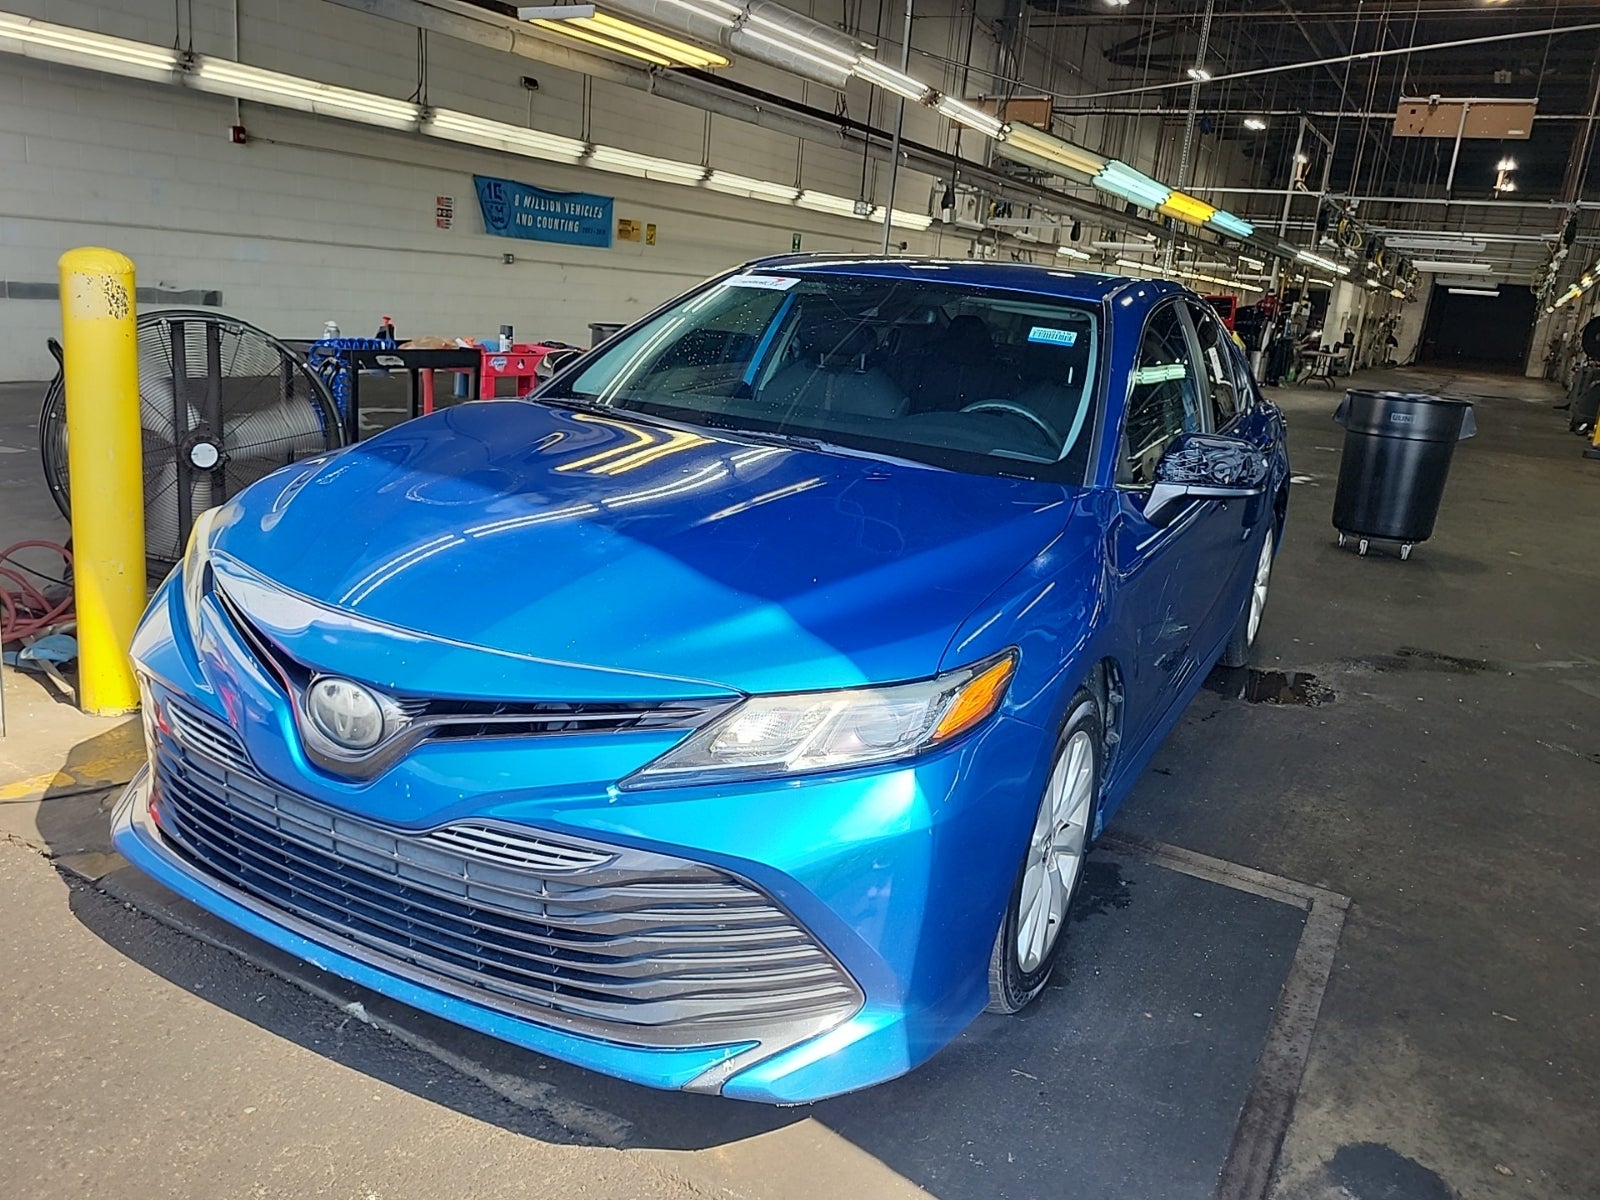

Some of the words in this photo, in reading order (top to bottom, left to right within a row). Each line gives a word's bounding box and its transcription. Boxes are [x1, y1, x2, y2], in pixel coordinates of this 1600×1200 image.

[523, 195, 561, 212] MILLION
[564, 203, 603, 219] VEHICLES
[516, 213, 533, 227] AND
[537, 217, 580, 233] COUNTING
